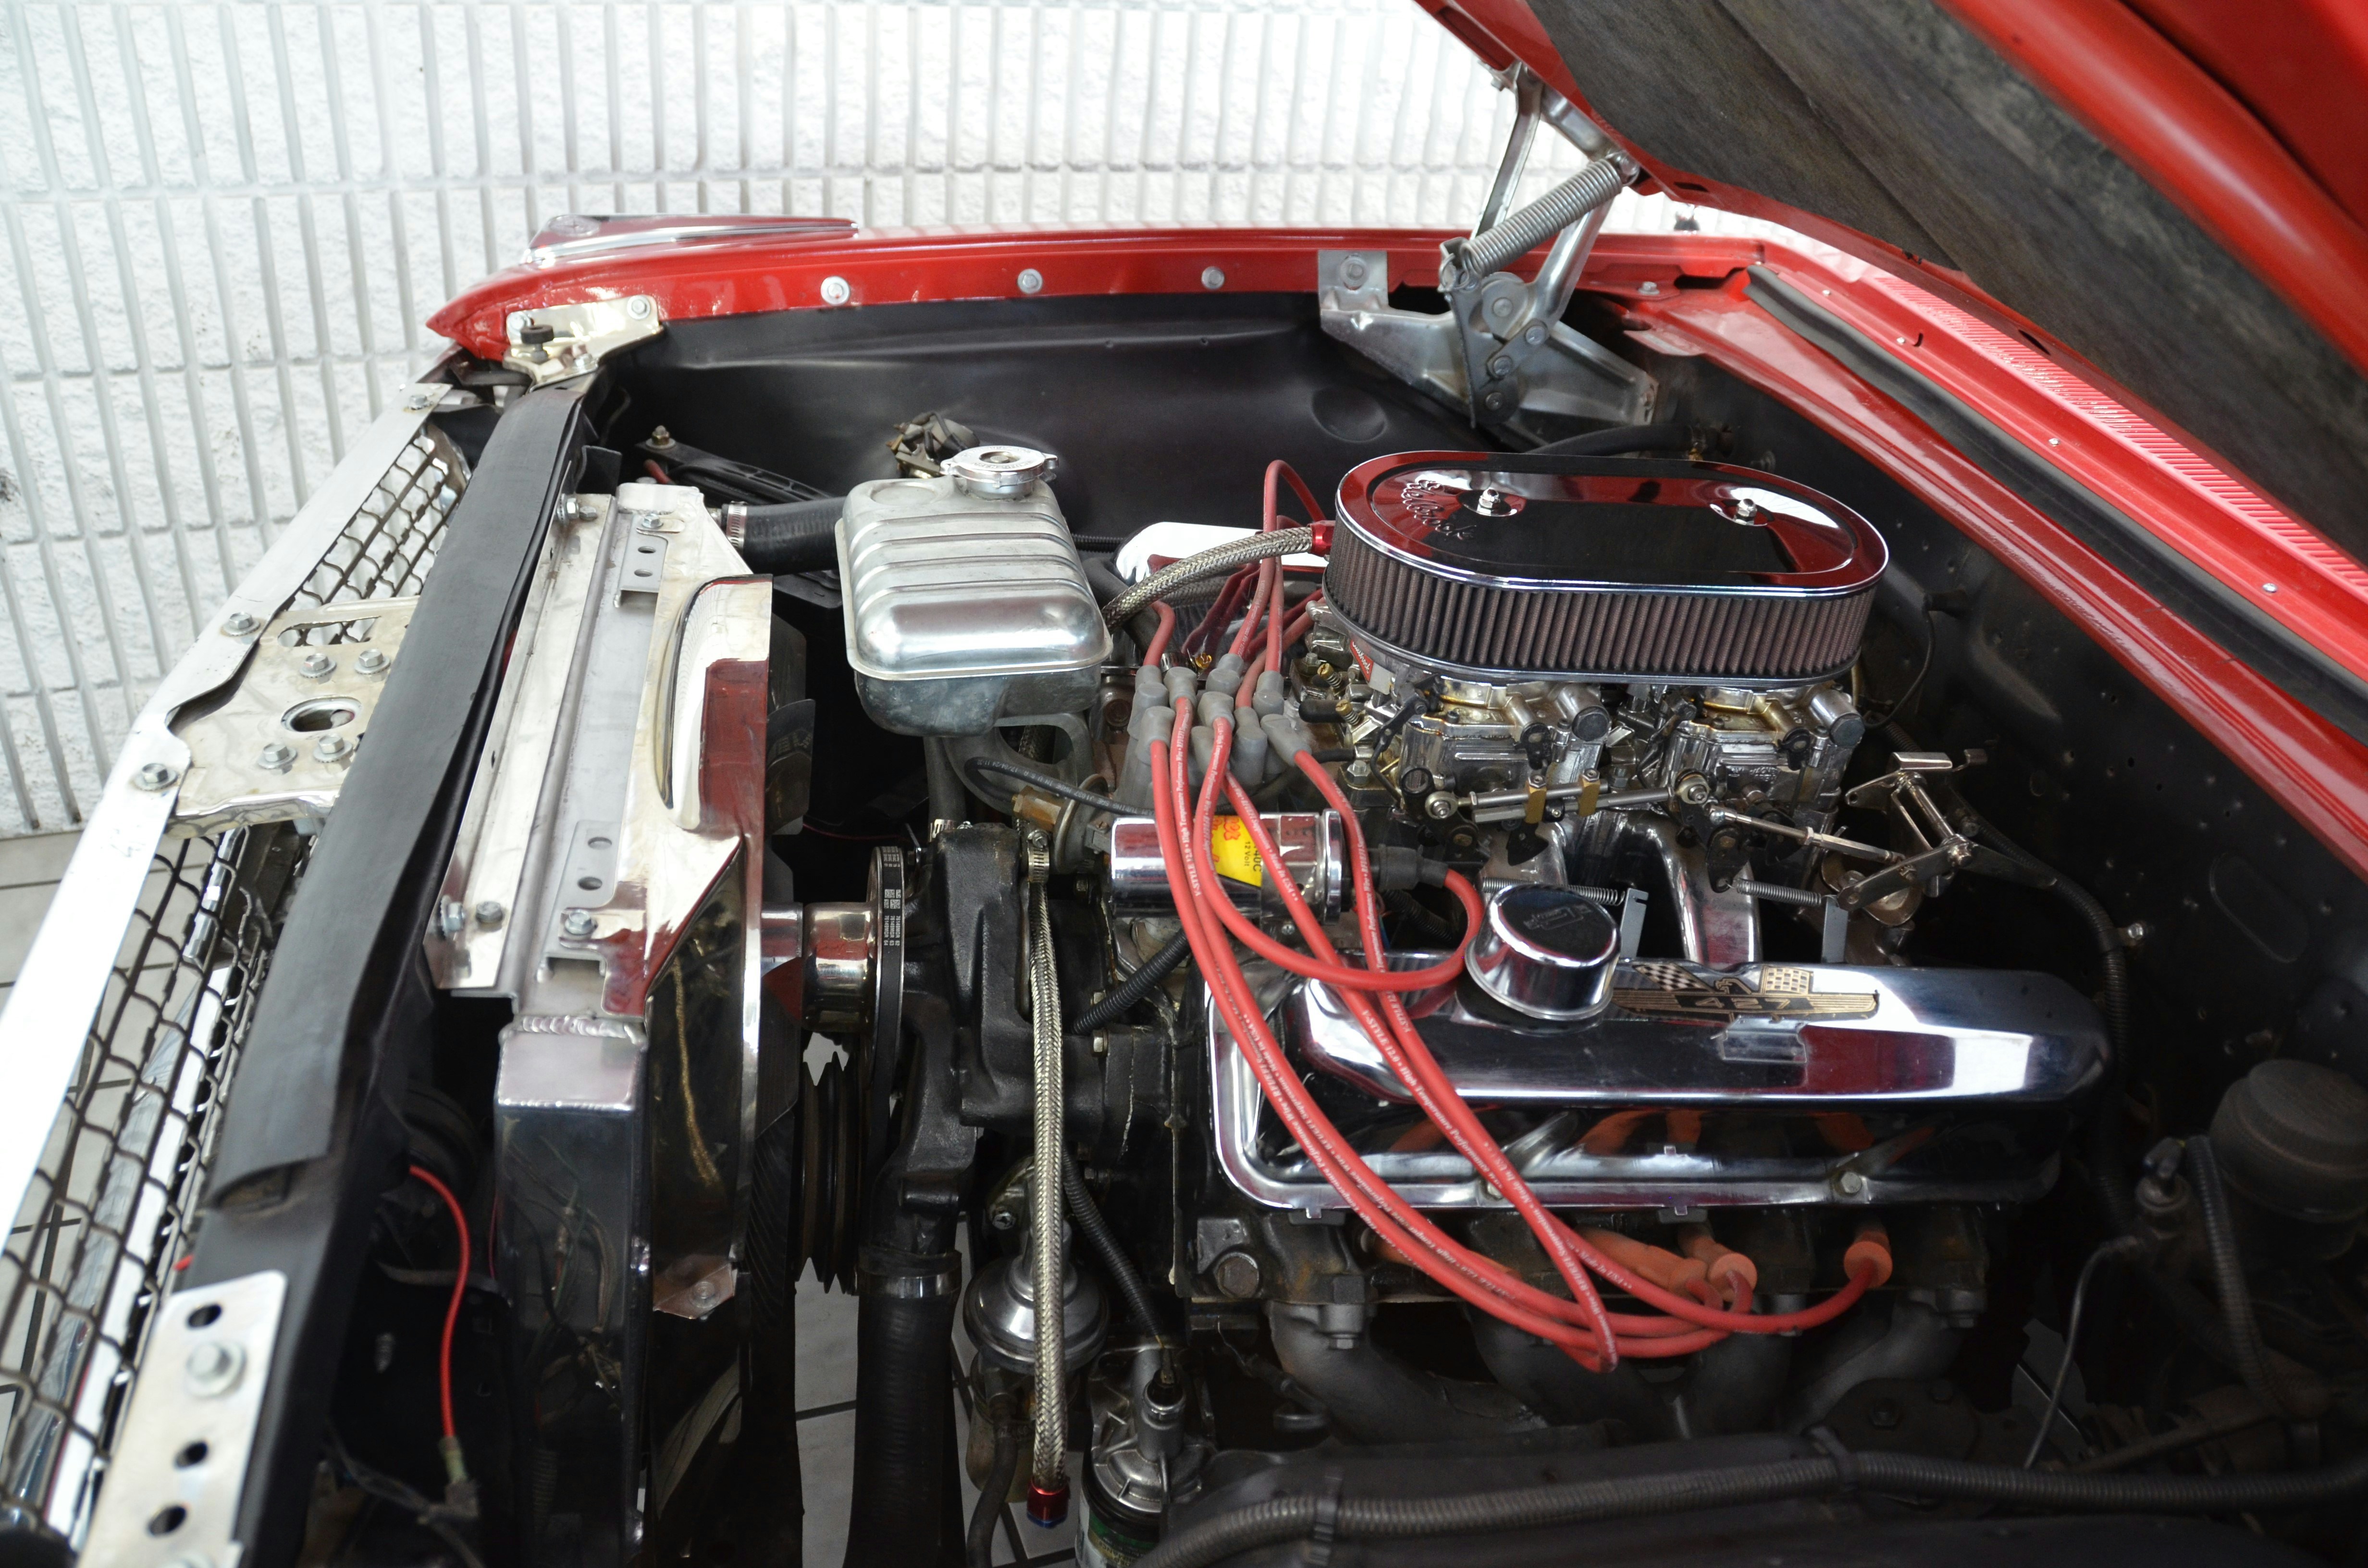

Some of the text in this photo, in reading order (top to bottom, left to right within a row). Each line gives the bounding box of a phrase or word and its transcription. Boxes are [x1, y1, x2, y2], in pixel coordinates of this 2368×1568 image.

[1044, 778, 1053, 786] IN
[1055, 782, 1073, 794] MADE
[1175, 761, 1184, 791] Performance
[1096, 797, 1110, 807] SAE
[1176, 792, 1188, 826] Temperature
[1180, 826, 1191, 843] High
[1183, 847, 1194, 862] 12.0
[1269, 852, 1283, 871] Made
[1186, 863, 1202, 897] V-STYLE
[1277, 868, 1287, 879] In
[1281, 876, 1296, 894] USA
[1363, 892, 1378, 931] Performance
[1390, 1001, 1413, 1034] V-STYLE
[1694, 997, 1791, 1010] 427
[1246, 1022, 1261, 1042] USA
[1256, 1041, 1266, 1052] In
[1261, 1050, 1279, 1073] Made
[1256, 1063, 1284, 1099] RFI/EFI
[1360, 1008, 1390, 1047] V-STYLE
[1383, 1043, 1401, 1064] 12.0
[1397, 1064, 1419, 1088] High
[1413, 1084, 1455, 1132] Temperature
[1447, 1127, 1492, 1175] Performance
[1275, 1075, 1311, 1121] Suppression
[1279, 1101, 1295, 1122] Wire
[1291, 1118, 1328, 1169] Performance
[1304, 1118, 1334, 1151] RFI/EFI
[1333, 1153, 1352, 1173] Wire
[1503, 1169, 1516, 1182] In
[1322, 1165, 1362, 1213] Temperature
[1349, 1168, 1394, 1213] Performance
[1510, 1179, 1533, 1205] Made
[1390, 1209, 1437, 1250] Temperature
[1530, 1207, 1569, 1258] Suppression
[1562, 1254, 1590, 1293] RFI/EFI
[1578, 1250, 1625, 1285] Made In USA
